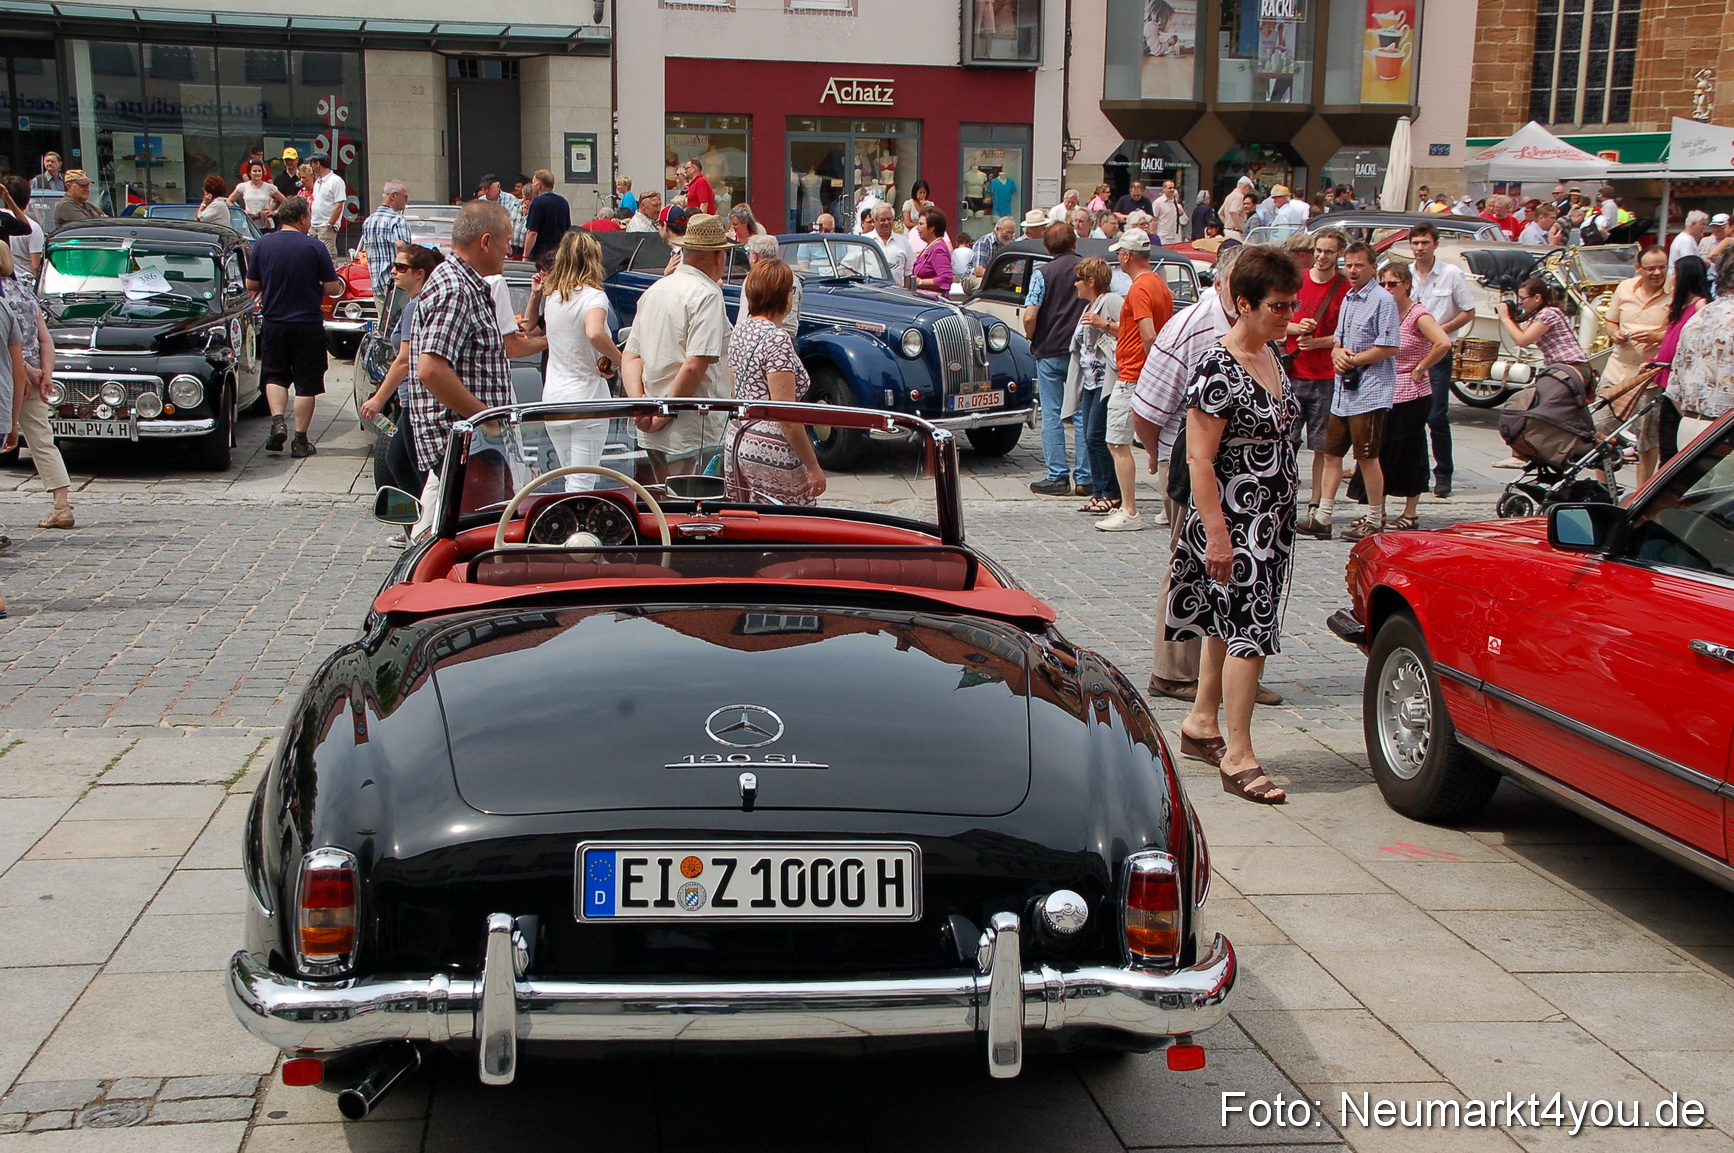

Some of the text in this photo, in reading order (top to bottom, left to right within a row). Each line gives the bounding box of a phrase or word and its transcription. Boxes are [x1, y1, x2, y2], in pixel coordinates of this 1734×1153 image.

[1261, 0, 1295, 17] RACKL
[820, 77, 894, 105] Achatz
[1141, 158, 1163, 170] RACKL
[1356, 164, 1376, 175] RACKL
[64, 364, 138, 372] OLVO
[958, 393, 1000, 408] R 07515
[86, 423, 102, 436] PV
[106, 424, 115, 436] 4
[119, 424, 127, 436] H
[683, 753, 811, 764] 190 SL
[621, 858, 676, 908] EI
[594, 890, 606, 905] D
